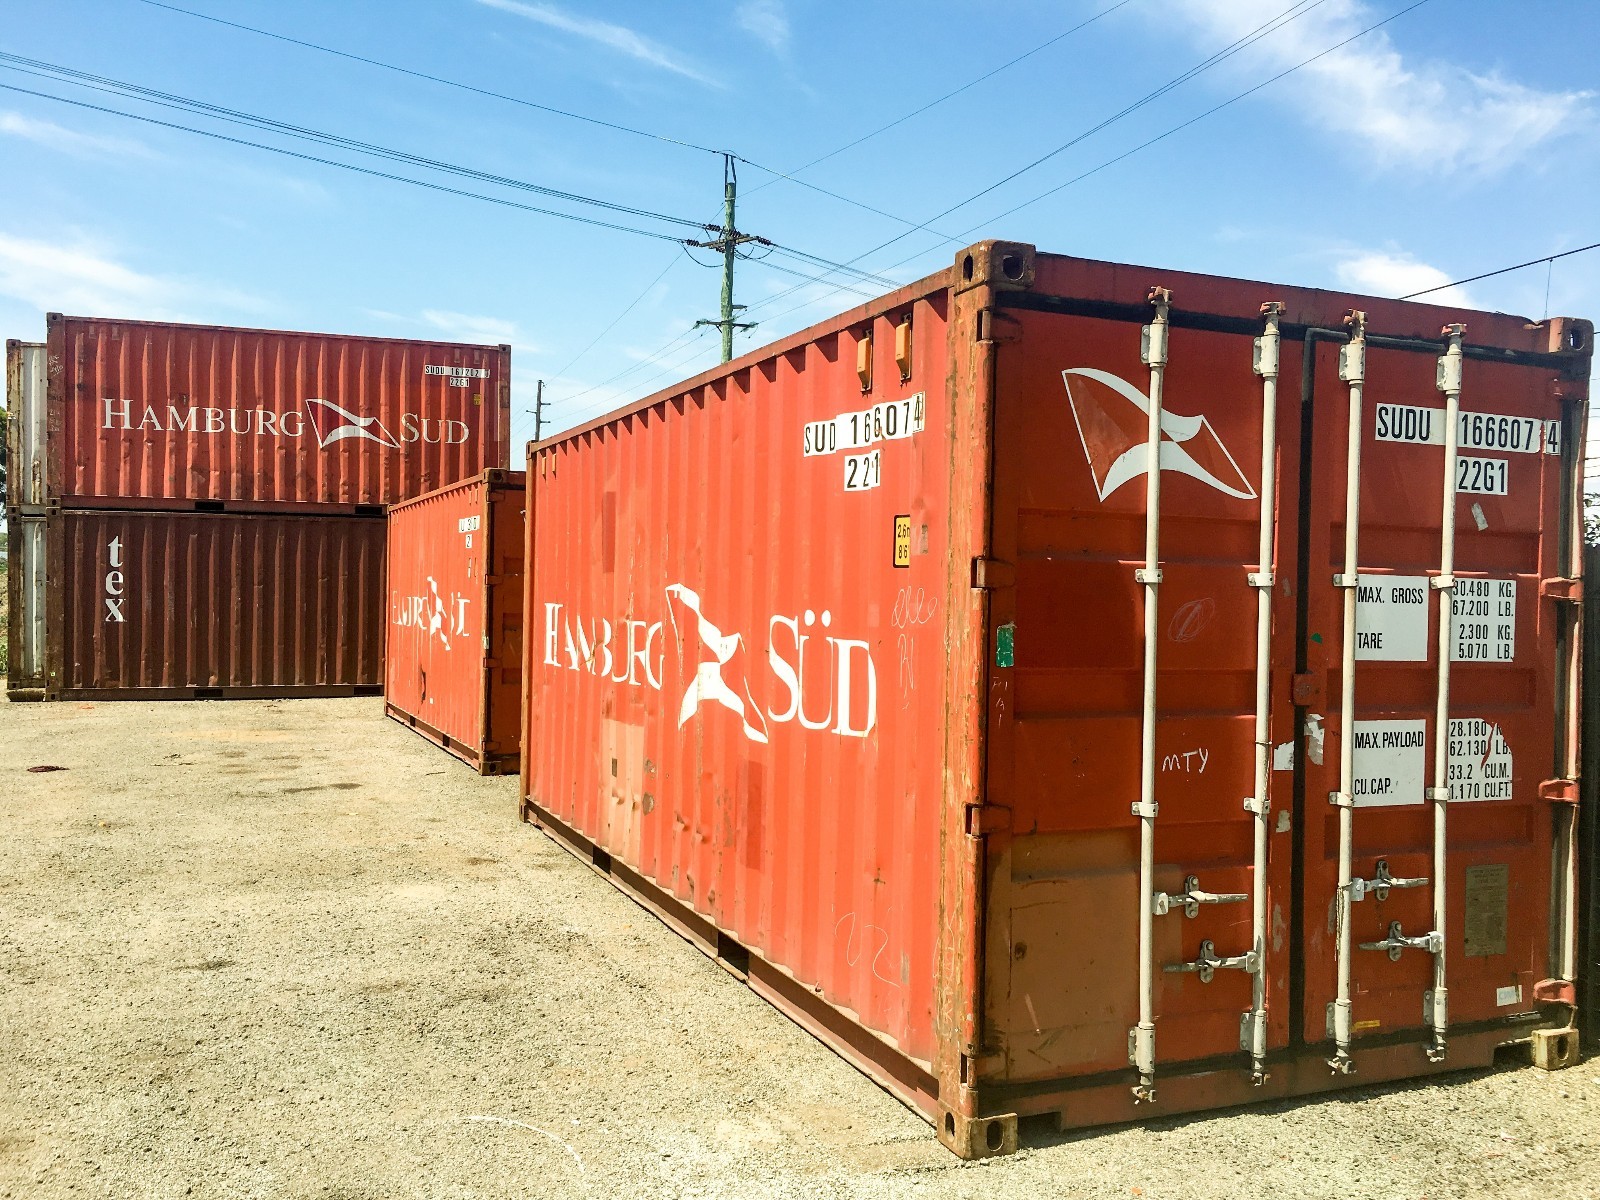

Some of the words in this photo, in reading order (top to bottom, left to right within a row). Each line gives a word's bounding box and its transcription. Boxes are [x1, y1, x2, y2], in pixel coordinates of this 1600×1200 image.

[101, 398, 306, 437] HAMBURG
[1377, 406, 1431, 442] SUDU
[1458, 459, 1506, 493] 22G1
[106, 535, 125, 622] tex
[1357, 587, 1385, 603] MAX.
[1391, 588, 1424, 604] GROSS
[1357, 633, 1383, 649] TARE
[767, 608, 877, 738] SÜD
[1354, 733, 1380, 749] MAX.
[1382, 732, 1424, 748] PAYLOAD
[1162, 748, 1209, 774] MTY
[1449, 764, 1473, 780] 33.2
